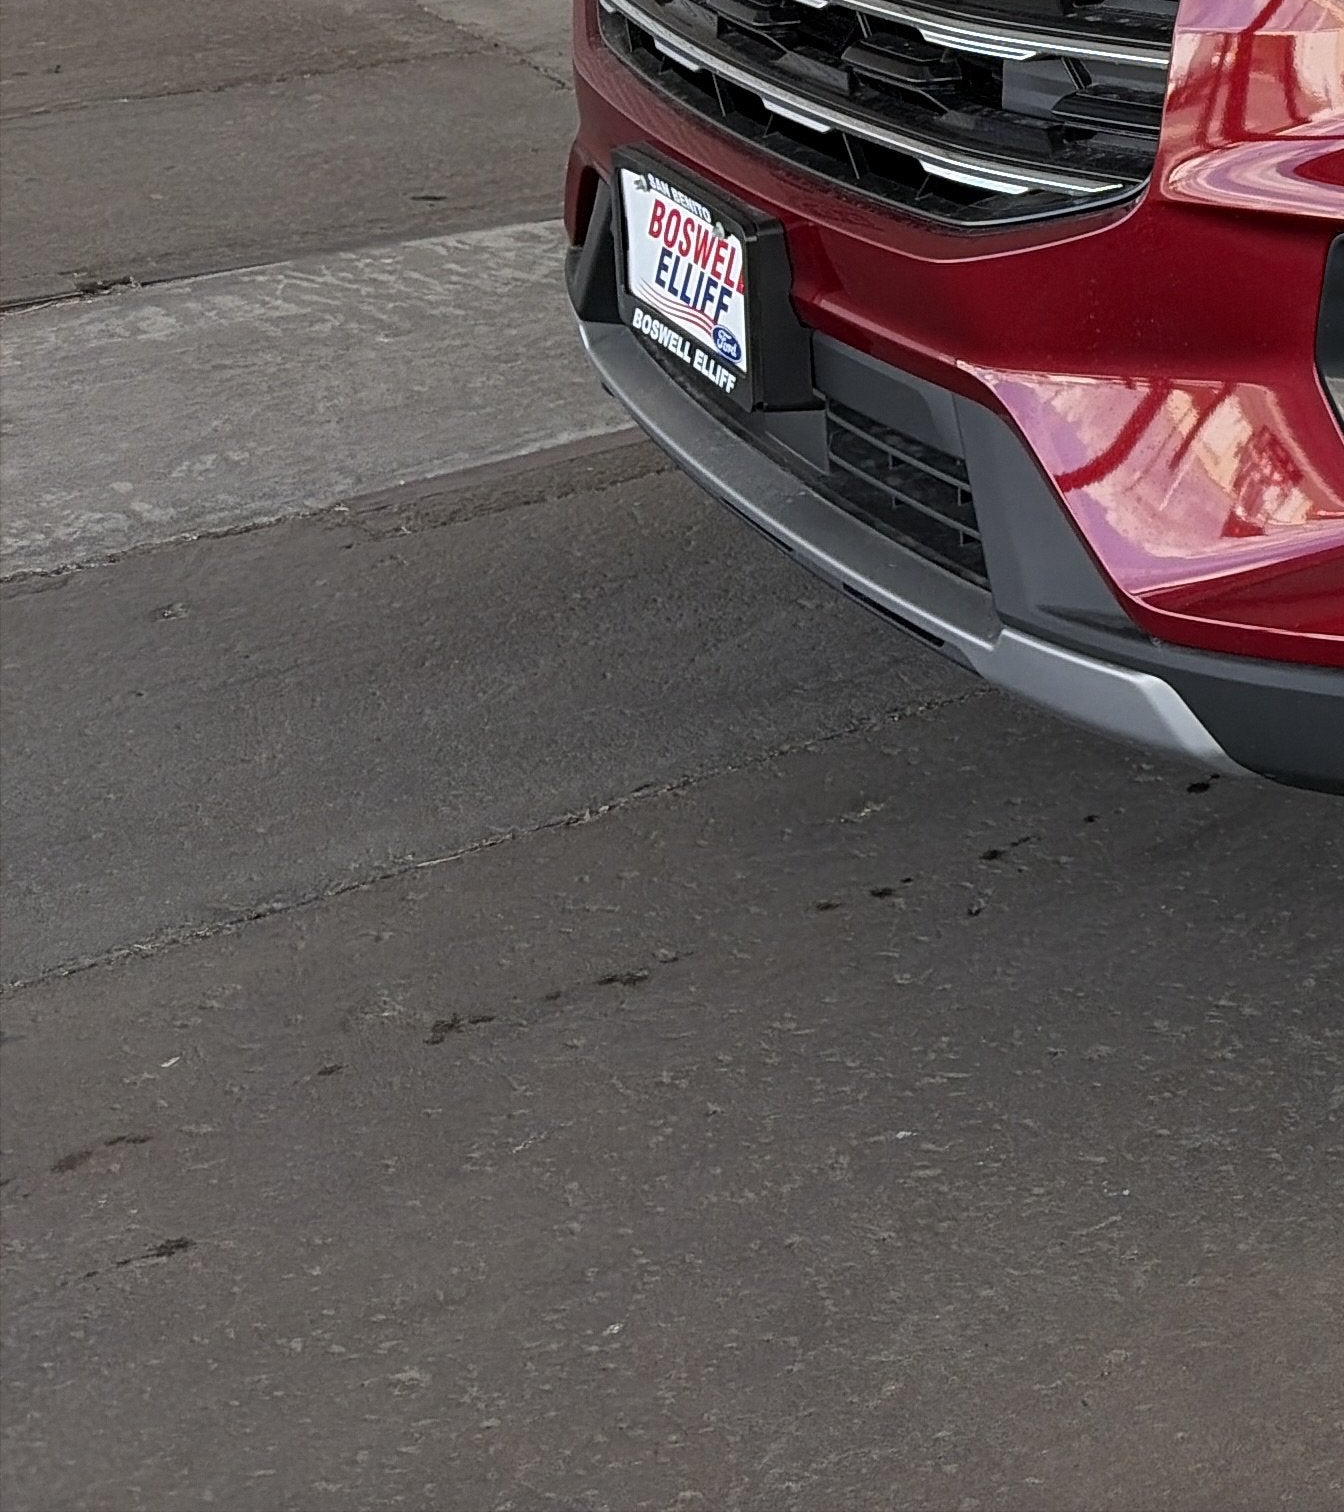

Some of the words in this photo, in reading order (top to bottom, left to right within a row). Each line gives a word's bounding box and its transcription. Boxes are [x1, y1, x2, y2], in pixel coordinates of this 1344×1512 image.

[647, 172, 672, 199] SAN
[670, 186, 712, 224] BENITO
[654, 245, 734, 326] ELLIFF
[632, 307, 692, 364] BOSWELL
[692, 348, 737, 394] ELLIFF
